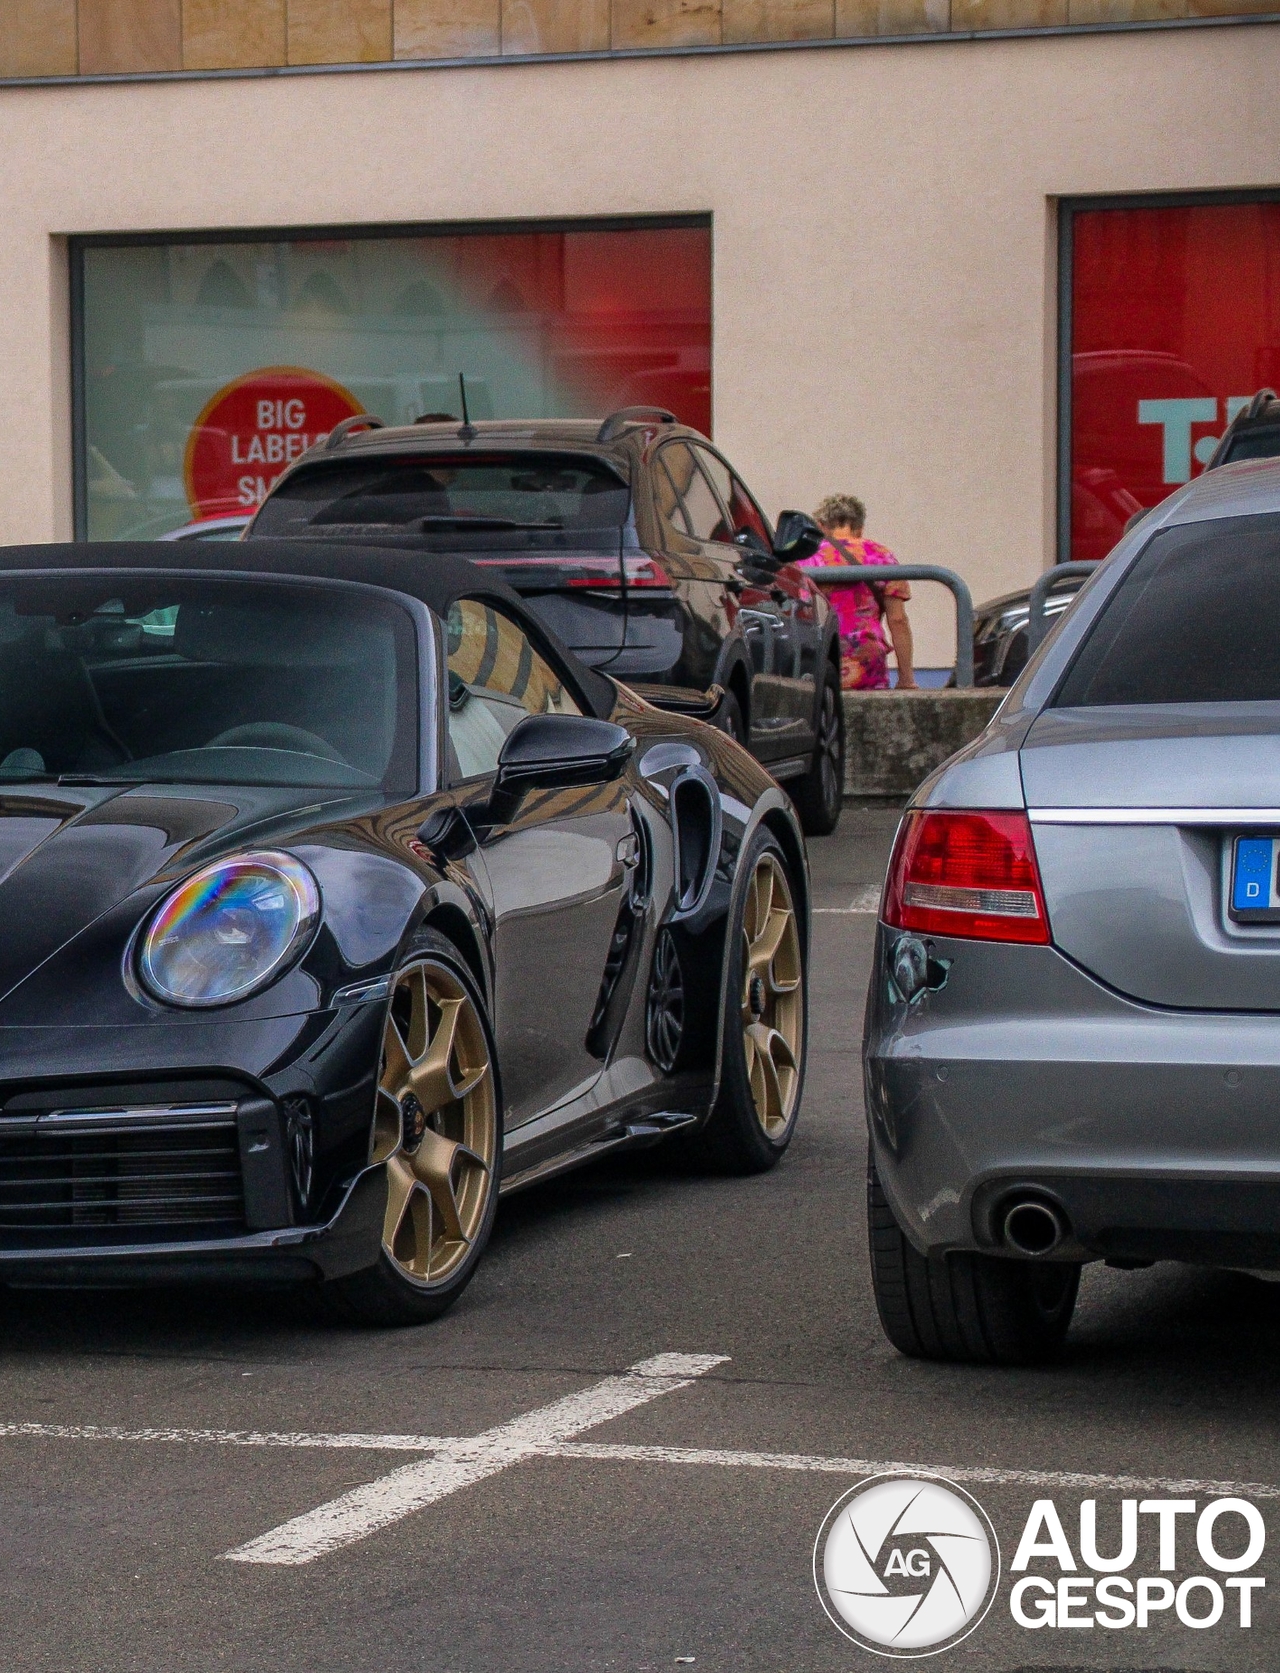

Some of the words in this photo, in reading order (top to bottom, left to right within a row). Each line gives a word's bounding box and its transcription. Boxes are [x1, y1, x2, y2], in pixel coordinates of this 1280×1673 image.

[257, 399, 306, 430] BIG
[231, 432, 329, 465] LABEL
[1246, 882, 1260, 898] D
